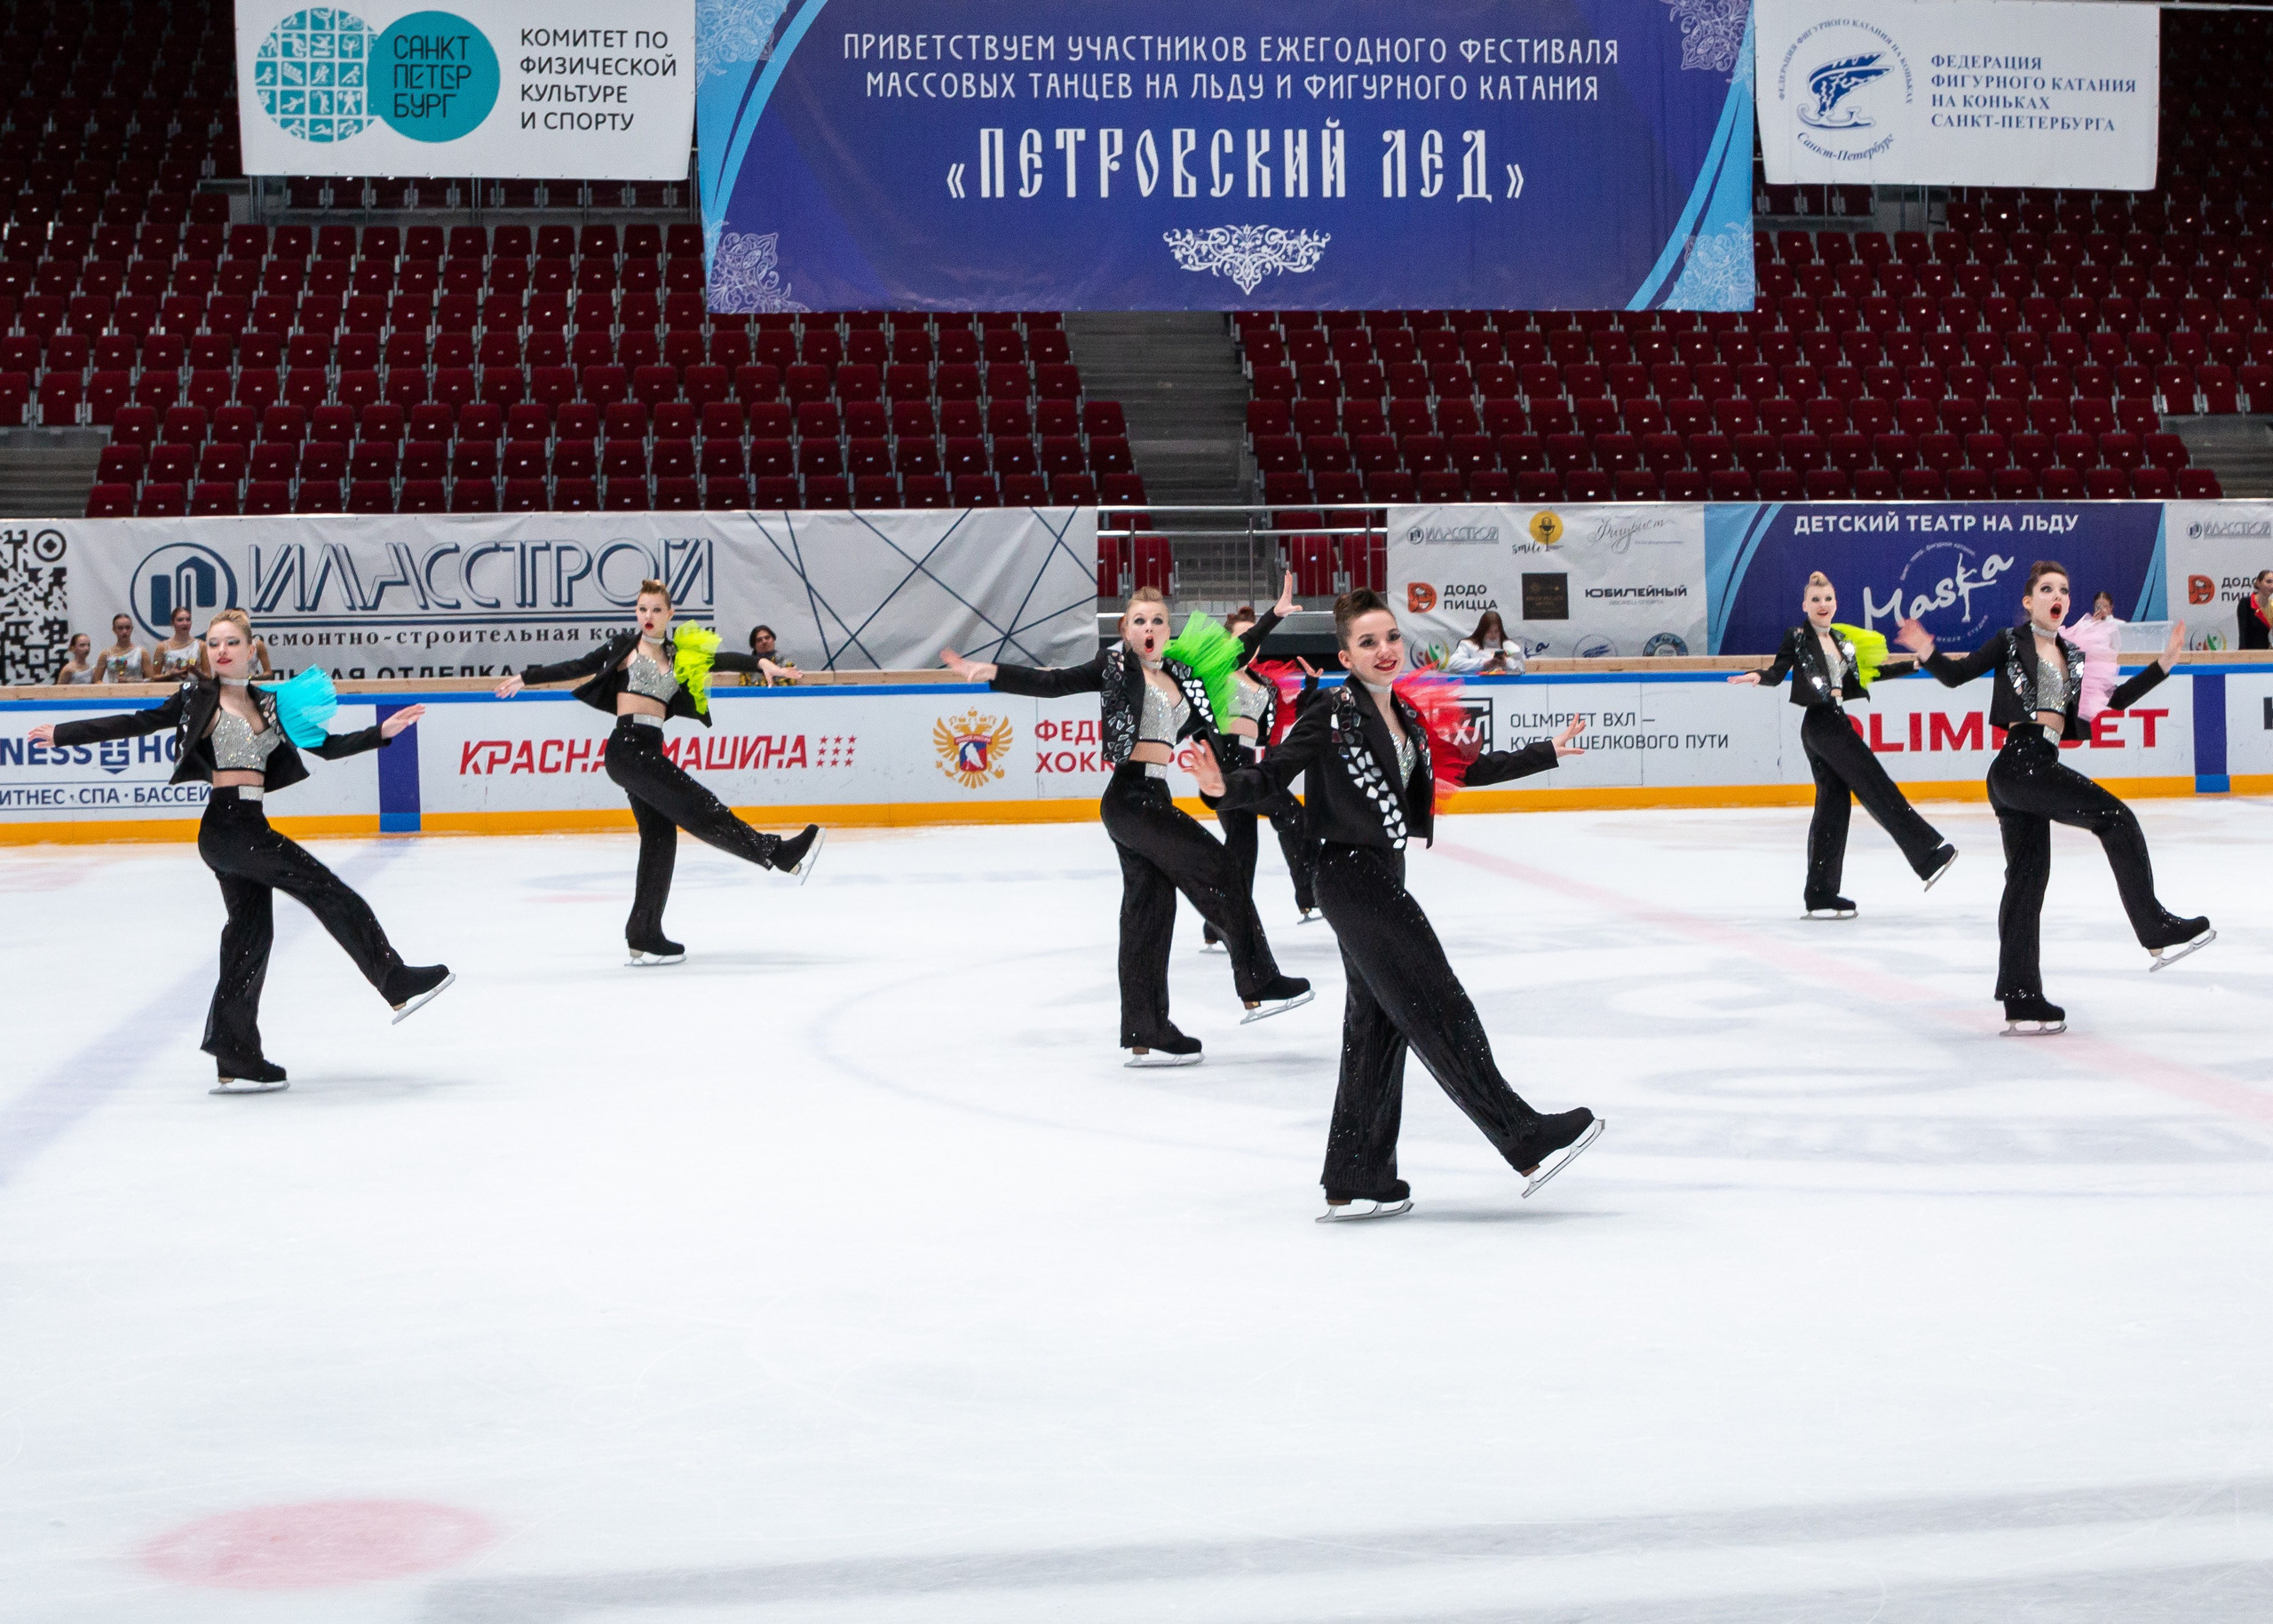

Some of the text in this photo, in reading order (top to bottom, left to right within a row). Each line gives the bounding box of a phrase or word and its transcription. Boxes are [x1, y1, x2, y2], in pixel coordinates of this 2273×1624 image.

[393, 34, 471, 60] САНКТ
[520, 28, 669, 50] КОМИТЕТ ПО
[843, 33, 1618, 66] ПРИВЕТСТВУЕМ УЧАСТНИКОВ ЕЖЕГОДНОГО ФЕСТИВАЛЯ
[519, 53, 677, 77] ФИЗИЧЕСКОЙ
[1930, 54, 2041, 70] ФЕДЕРАЦИЯ
[393, 64, 472, 91] ПЕТЕР
[867, 72, 1598, 102] МАССОВЫХ ТАНЦЕВ НА ЛЬДУ И ФИГУРНОГО КАТАНИЯ
[1930, 74, 2136, 93] ФИГУРНОГО КАТАНИЯ
[520, 83, 628, 104] КУЛЬТУРЕ
[1932, 93, 2050, 110] НА КОНЬКАХ
[393, 91, 457, 119] БУРГ
[521, 111, 635, 131] И СПОРТУ
[1930, 114, 2115, 131] САНКТ-ПЕТЕРБУРГА
[946, 116, 1525, 202] «ПЕТРОВСКИЙ ЛЕД»
[1794, 511, 2079, 535] ДЕТСКИЙ ТЕАТР НА ЛЬДУ
[1443, 583, 1488, 598] ДОДО
[1585, 584, 1688, 598] ЮБИЛЕЙНЫЙ
[1443, 599, 1499, 613] ПИЦЦА
[1603, 711, 1636, 727] ВХЛ
[1572, 734, 1729, 750] ШЕЛКОВОГО ПУТИ
[79, 788, 120, 804] СПА
